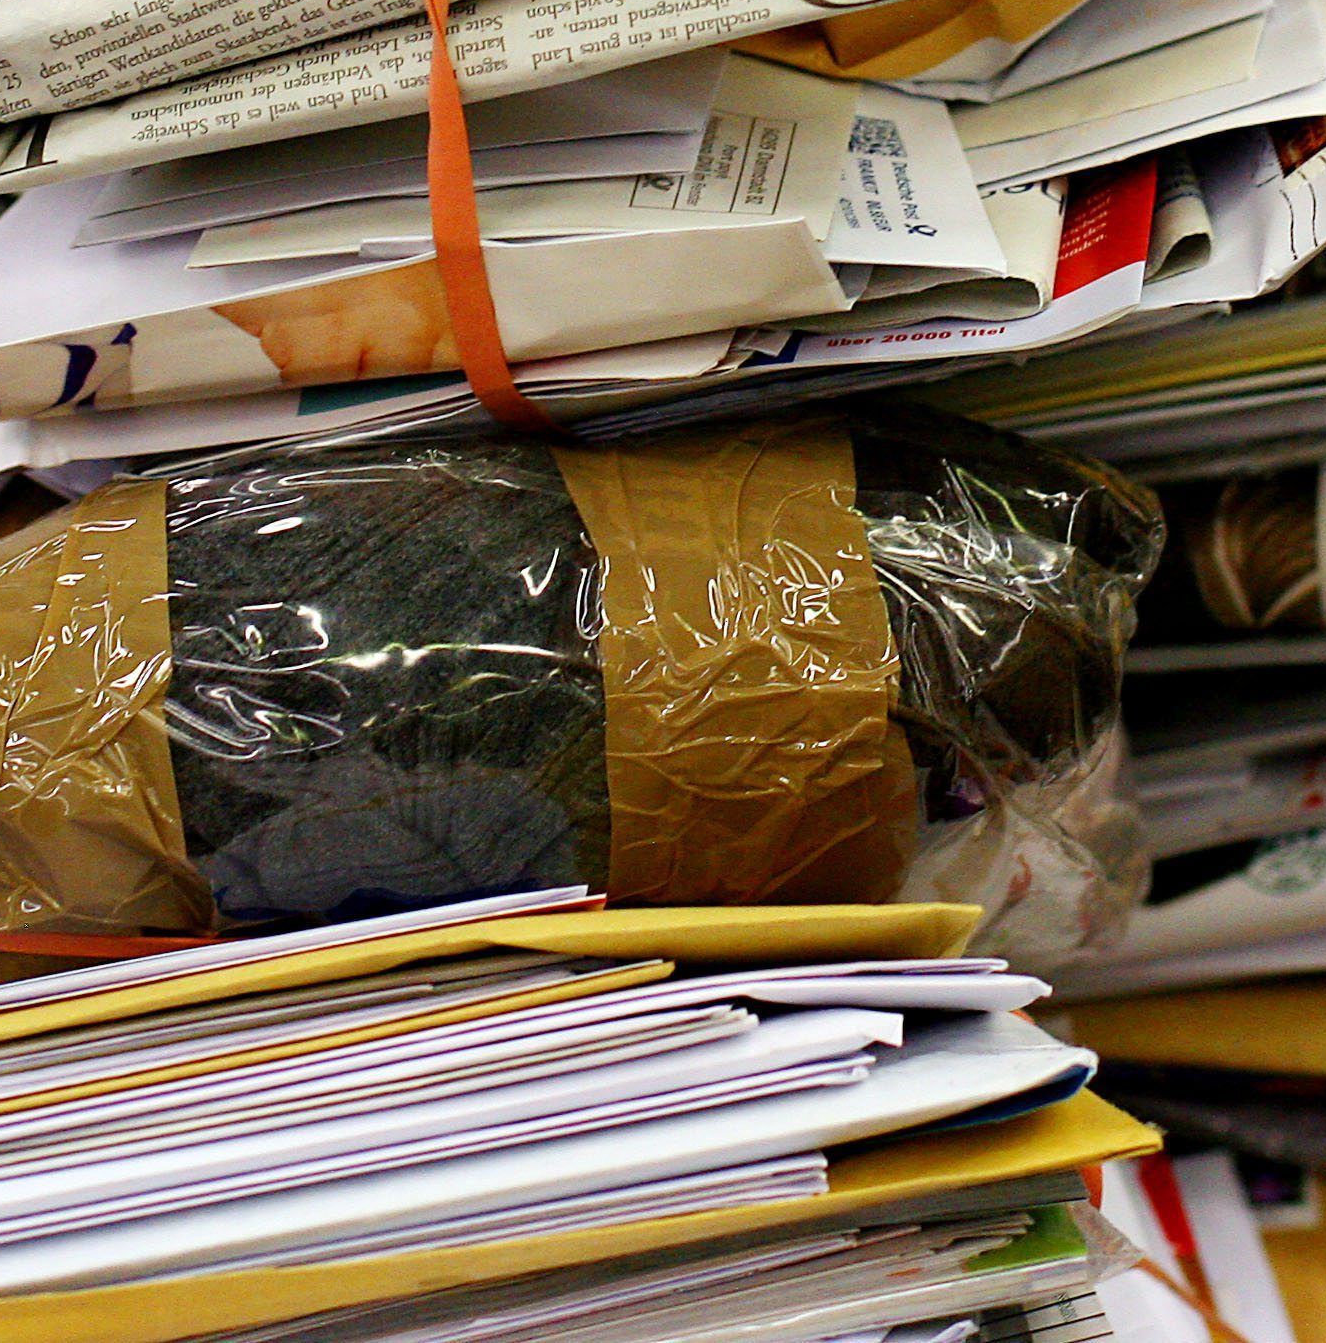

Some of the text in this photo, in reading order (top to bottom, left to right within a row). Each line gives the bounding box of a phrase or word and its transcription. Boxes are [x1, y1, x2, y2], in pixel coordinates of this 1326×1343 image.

[300, 7, 324, 23] das
[526, 1, 571, 20] schon
[49, 26, 96, 50] Schon
[100, 10, 132, 31] sehr
[465, 15, 503, 32] Seite
[529, 27, 554, 40] an-
[563, 14, 618, 33] netten,
[345, 37, 399, 57] Lebens
[455, 36, 506, 61] kartell
[532, 8, 770, 71] eutschland ist ein gutes Land
[39, 61, 72, 79] den,
[75, 23, 165, 70] provinziellen
[47, 69, 109, 98] bärtigen
[232, 10, 256, 27] die
[296, 51, 340, 72] durch
[379, 56, 404, 74] das
[464, 57, 508, 77] sagen
[2, 72, 22, 91] 25
[284, 65, 372, 90] Verdrängen
[251, 83, 276, 97] der
[351, 83, 388, 106] Und
[131, 90, 243, 121] unmoralischen
[307, 91, 344, 110] eben
[215, 112, 240, 128] das
[247, 107, 262, 120] es
[268, 101, 301, 122] weil
[132, 118, 209, 142] Schweige-
[959, 326, 1006, 338] Titel
